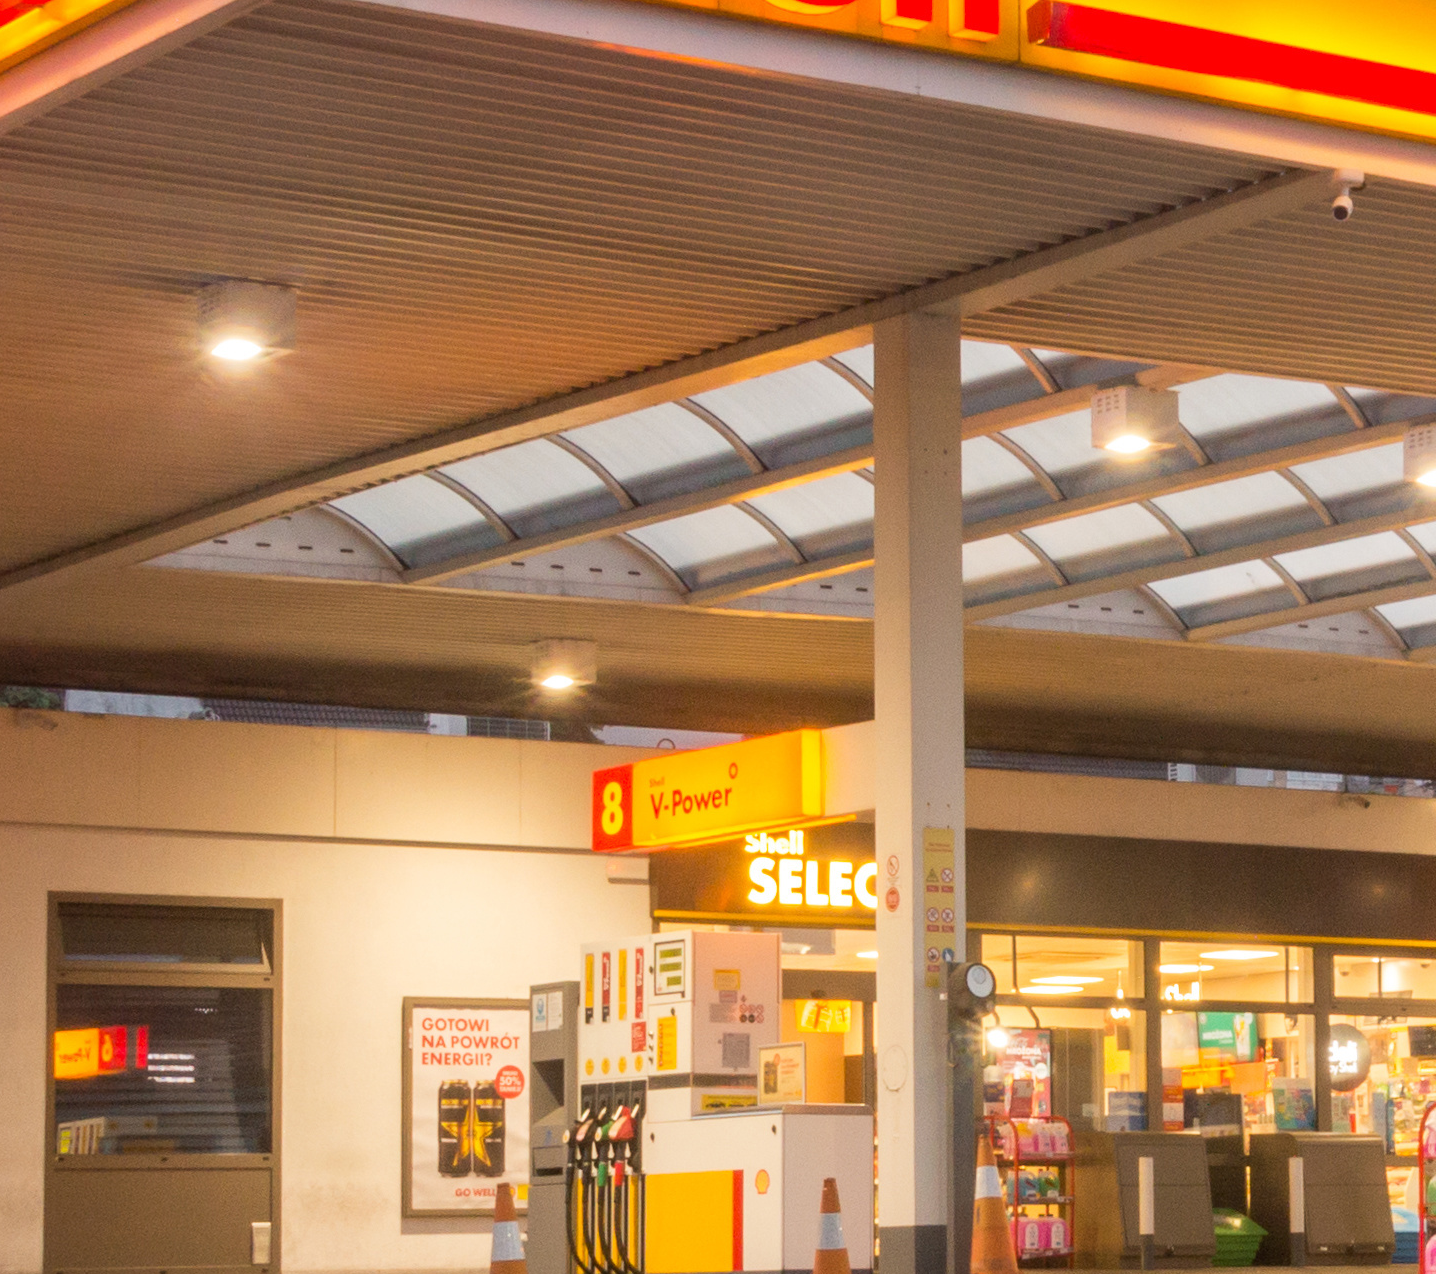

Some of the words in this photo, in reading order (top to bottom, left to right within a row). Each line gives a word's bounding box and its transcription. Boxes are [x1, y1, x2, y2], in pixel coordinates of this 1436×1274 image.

[601, 781, 624, 836] 8
[650, 787, 732, 819] V-Power
[744, 829, 805, 855] Shell
[747, 856, 878, 909] SELEC
[421, 1017, 489, 1032] GOTOWI
[421, 1035, 446, 1048] NA
[451, 1032, 520, 1049] POWRÓT
[421, 1052, 493, 1066] ENERGII?
[455, 1188, 471, 1197] GO
